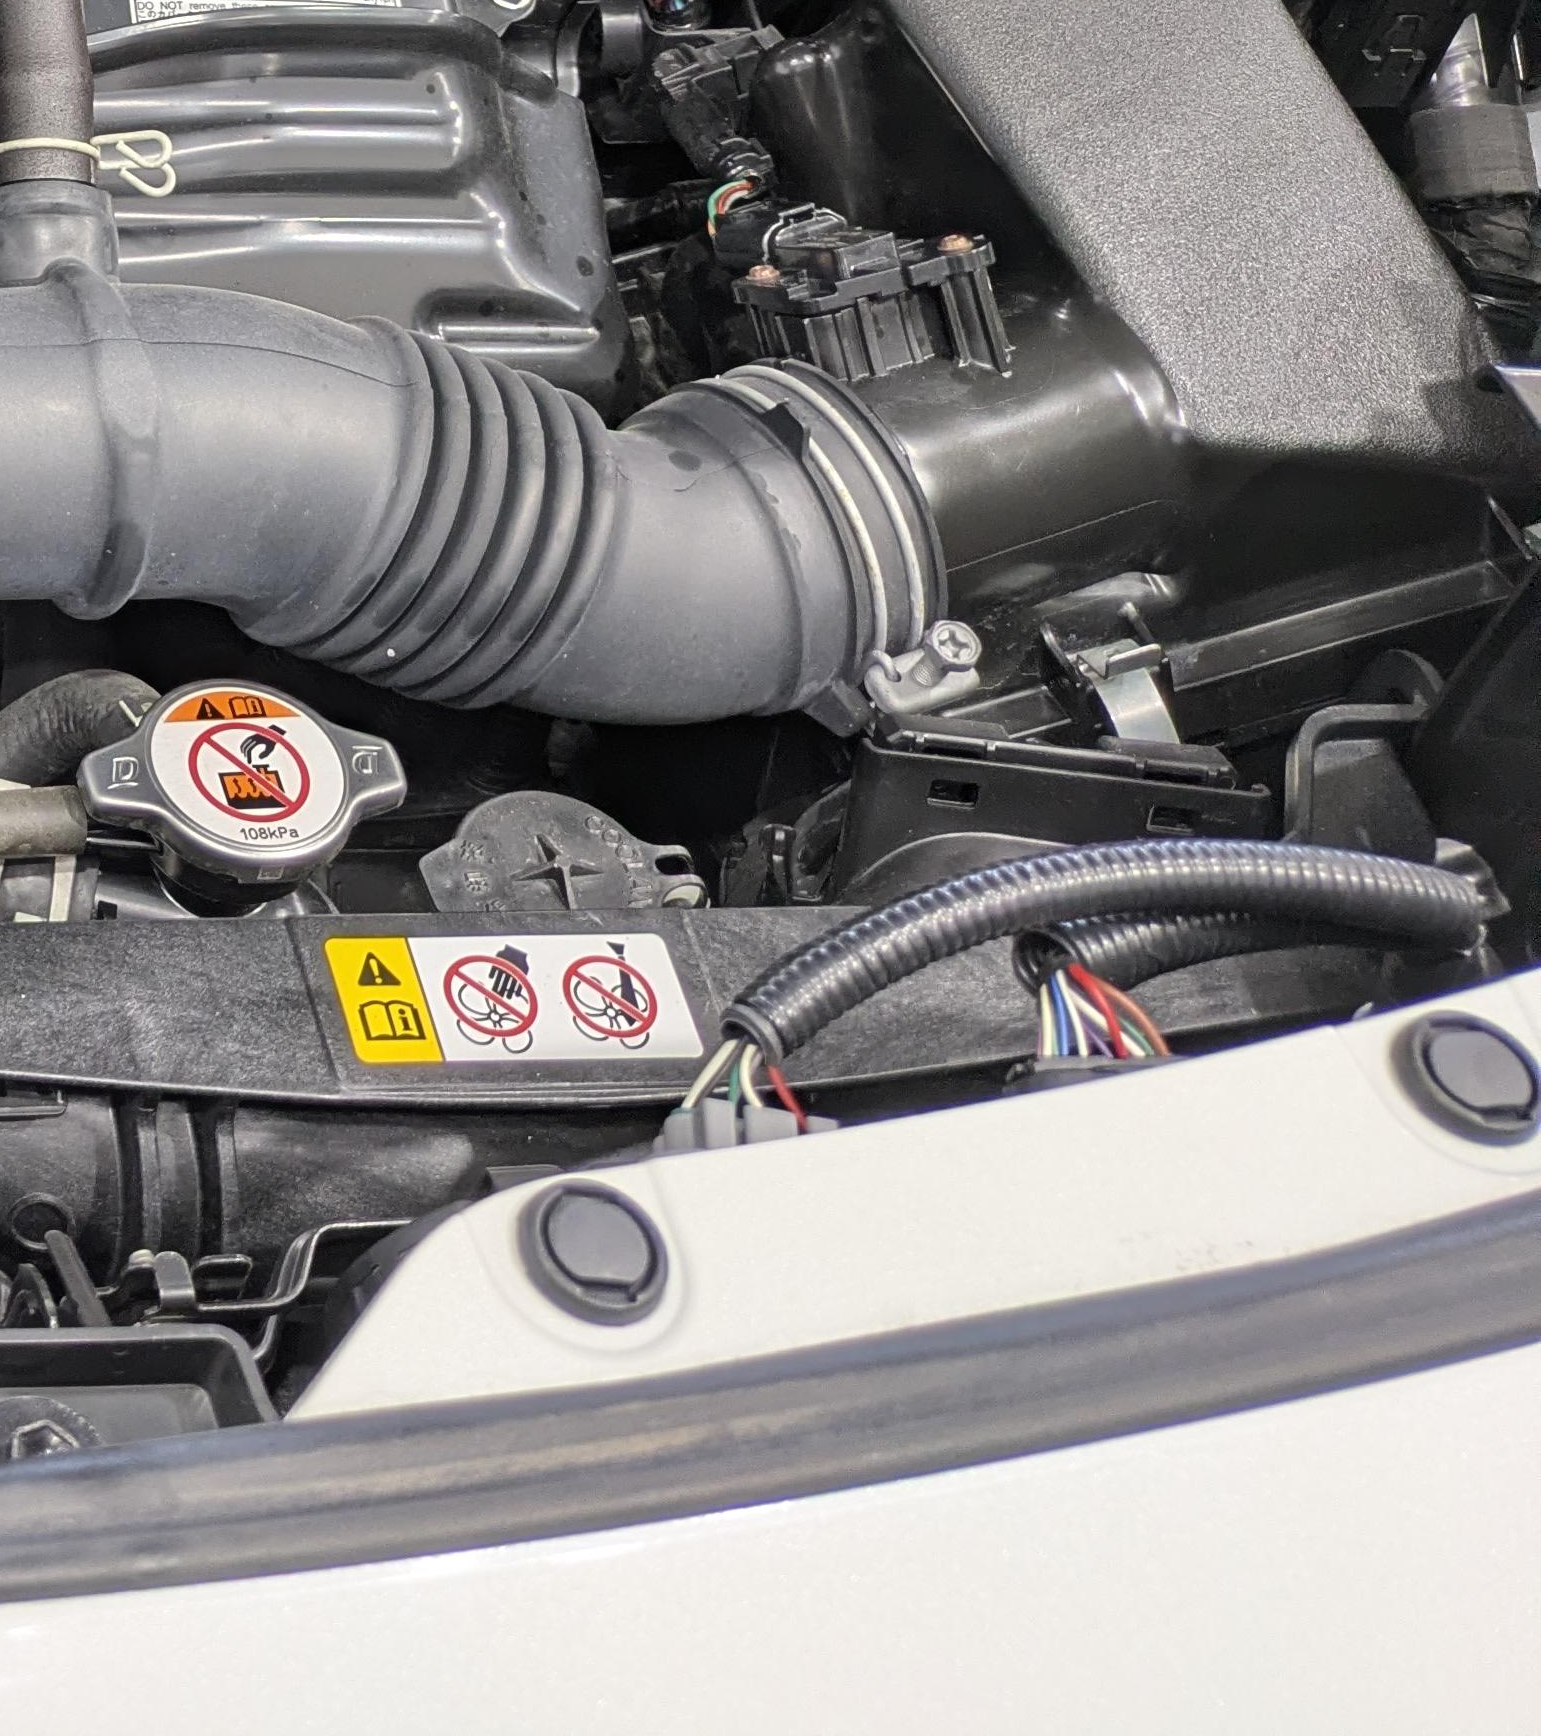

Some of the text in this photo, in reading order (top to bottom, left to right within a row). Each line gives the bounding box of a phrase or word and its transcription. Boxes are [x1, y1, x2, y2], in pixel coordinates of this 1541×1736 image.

[137, 1, 154, 11] DO
[160, 1, 183, 10] NOT
[239, 827, 300, 841] 108kPa
